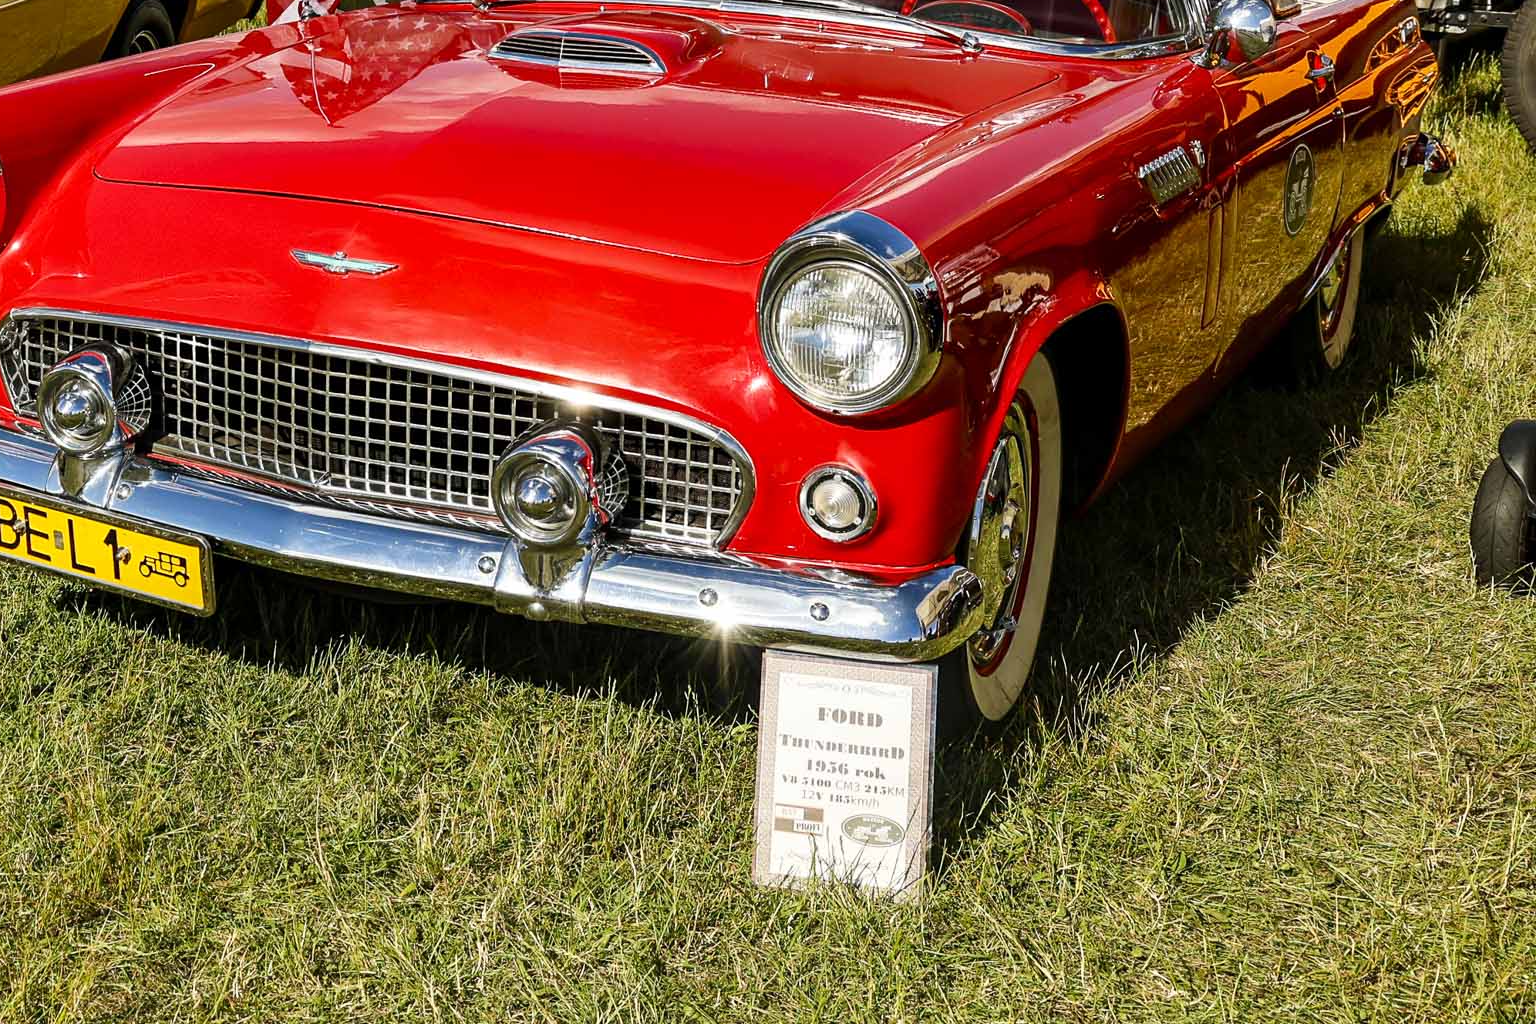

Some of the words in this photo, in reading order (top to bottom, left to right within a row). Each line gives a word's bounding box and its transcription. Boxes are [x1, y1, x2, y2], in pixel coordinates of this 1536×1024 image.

[817, 707, 884, 728] FORD
[807, 759, 849, 775] 1956
[855, 767, 886, 780] rok
[802, 777, 832, 788] 5100
